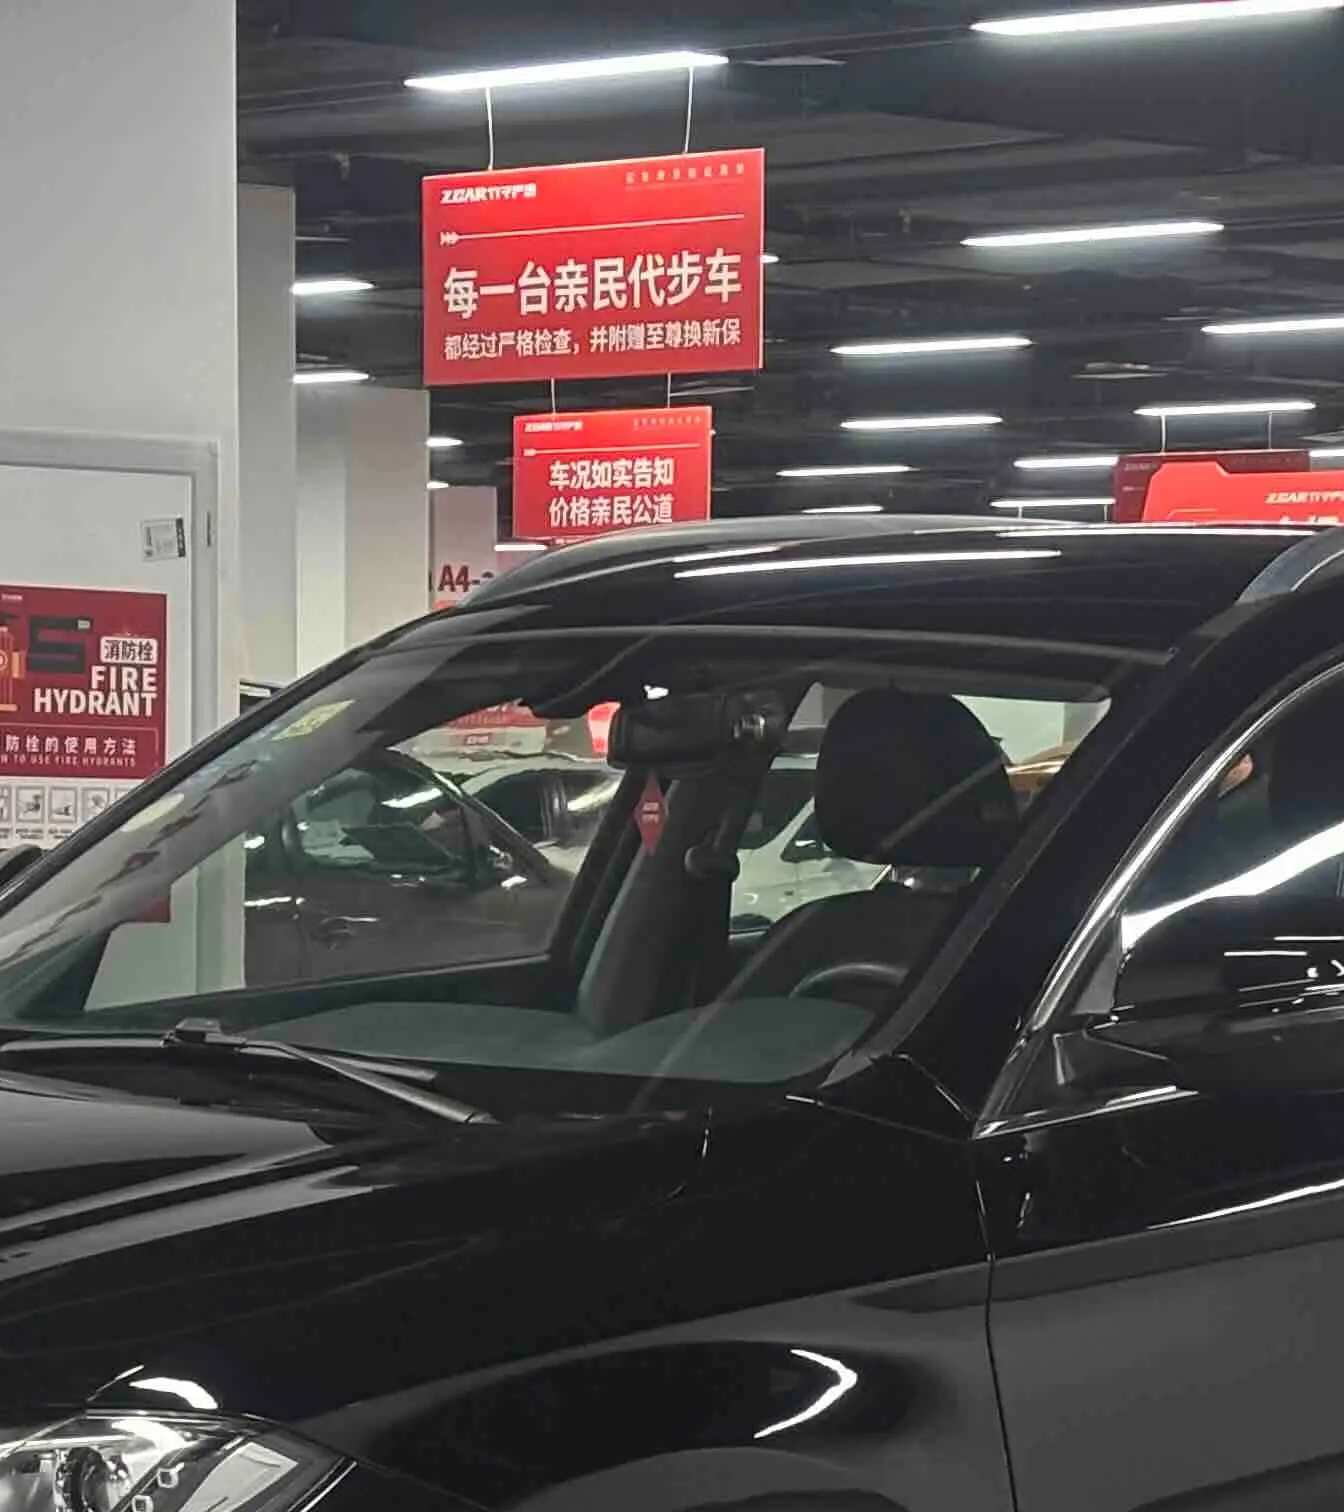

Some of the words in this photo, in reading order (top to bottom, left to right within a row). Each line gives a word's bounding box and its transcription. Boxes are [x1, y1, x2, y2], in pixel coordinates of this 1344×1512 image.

[443, 248, 742, 319] 每一台亲民代步车
[549, 457, 674, 491] 车况如实告知
[548, 494, 674, 528] 价格亲民公道
[104, 639, 154, 662] 消防栓
[91, 665, 157, 691] FIRE
[33, 687, 157, 717] HYDRANT
